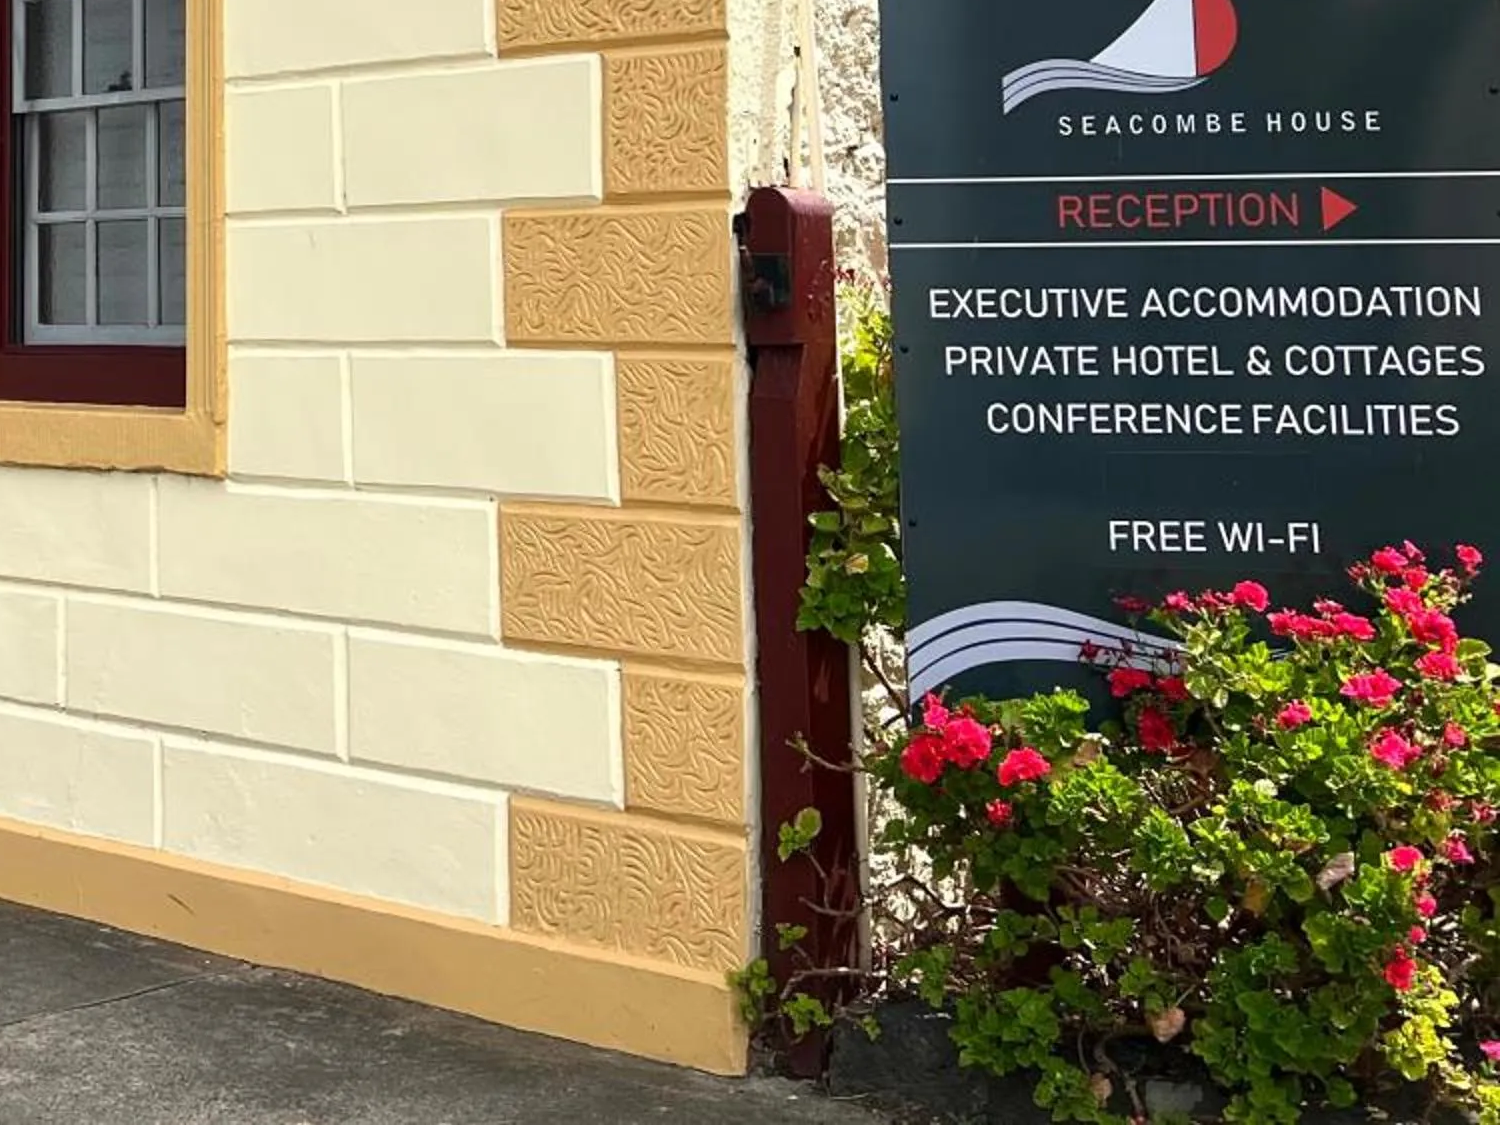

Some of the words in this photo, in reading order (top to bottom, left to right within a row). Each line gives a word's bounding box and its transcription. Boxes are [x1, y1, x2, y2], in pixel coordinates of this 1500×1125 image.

[1058, 112, 1247, 136] SEACOMBE
[1266, 110, 1381, 132] HOUSE
[1059, 193, 1298, 228] RECEPTION
[929, 287, 1129, 319] EXECUTIVE
[1140, 286, 1481, 318] ACCOMMODATION
[945, 345, 1100, 376] PRIVATE
[1112, 345, 1235, 376] HOTEL
[1246, 344, 1273, 376] &
[1285, 344, 1485, 376] COTTAGES
[987, 402, 1244, 434] CONFERENCE
[1252, 404, 1460, 436] FACILITIES
[1109, 520, 1207, 552] FREE
[1217, 521, 1320, 554] WI-FI
